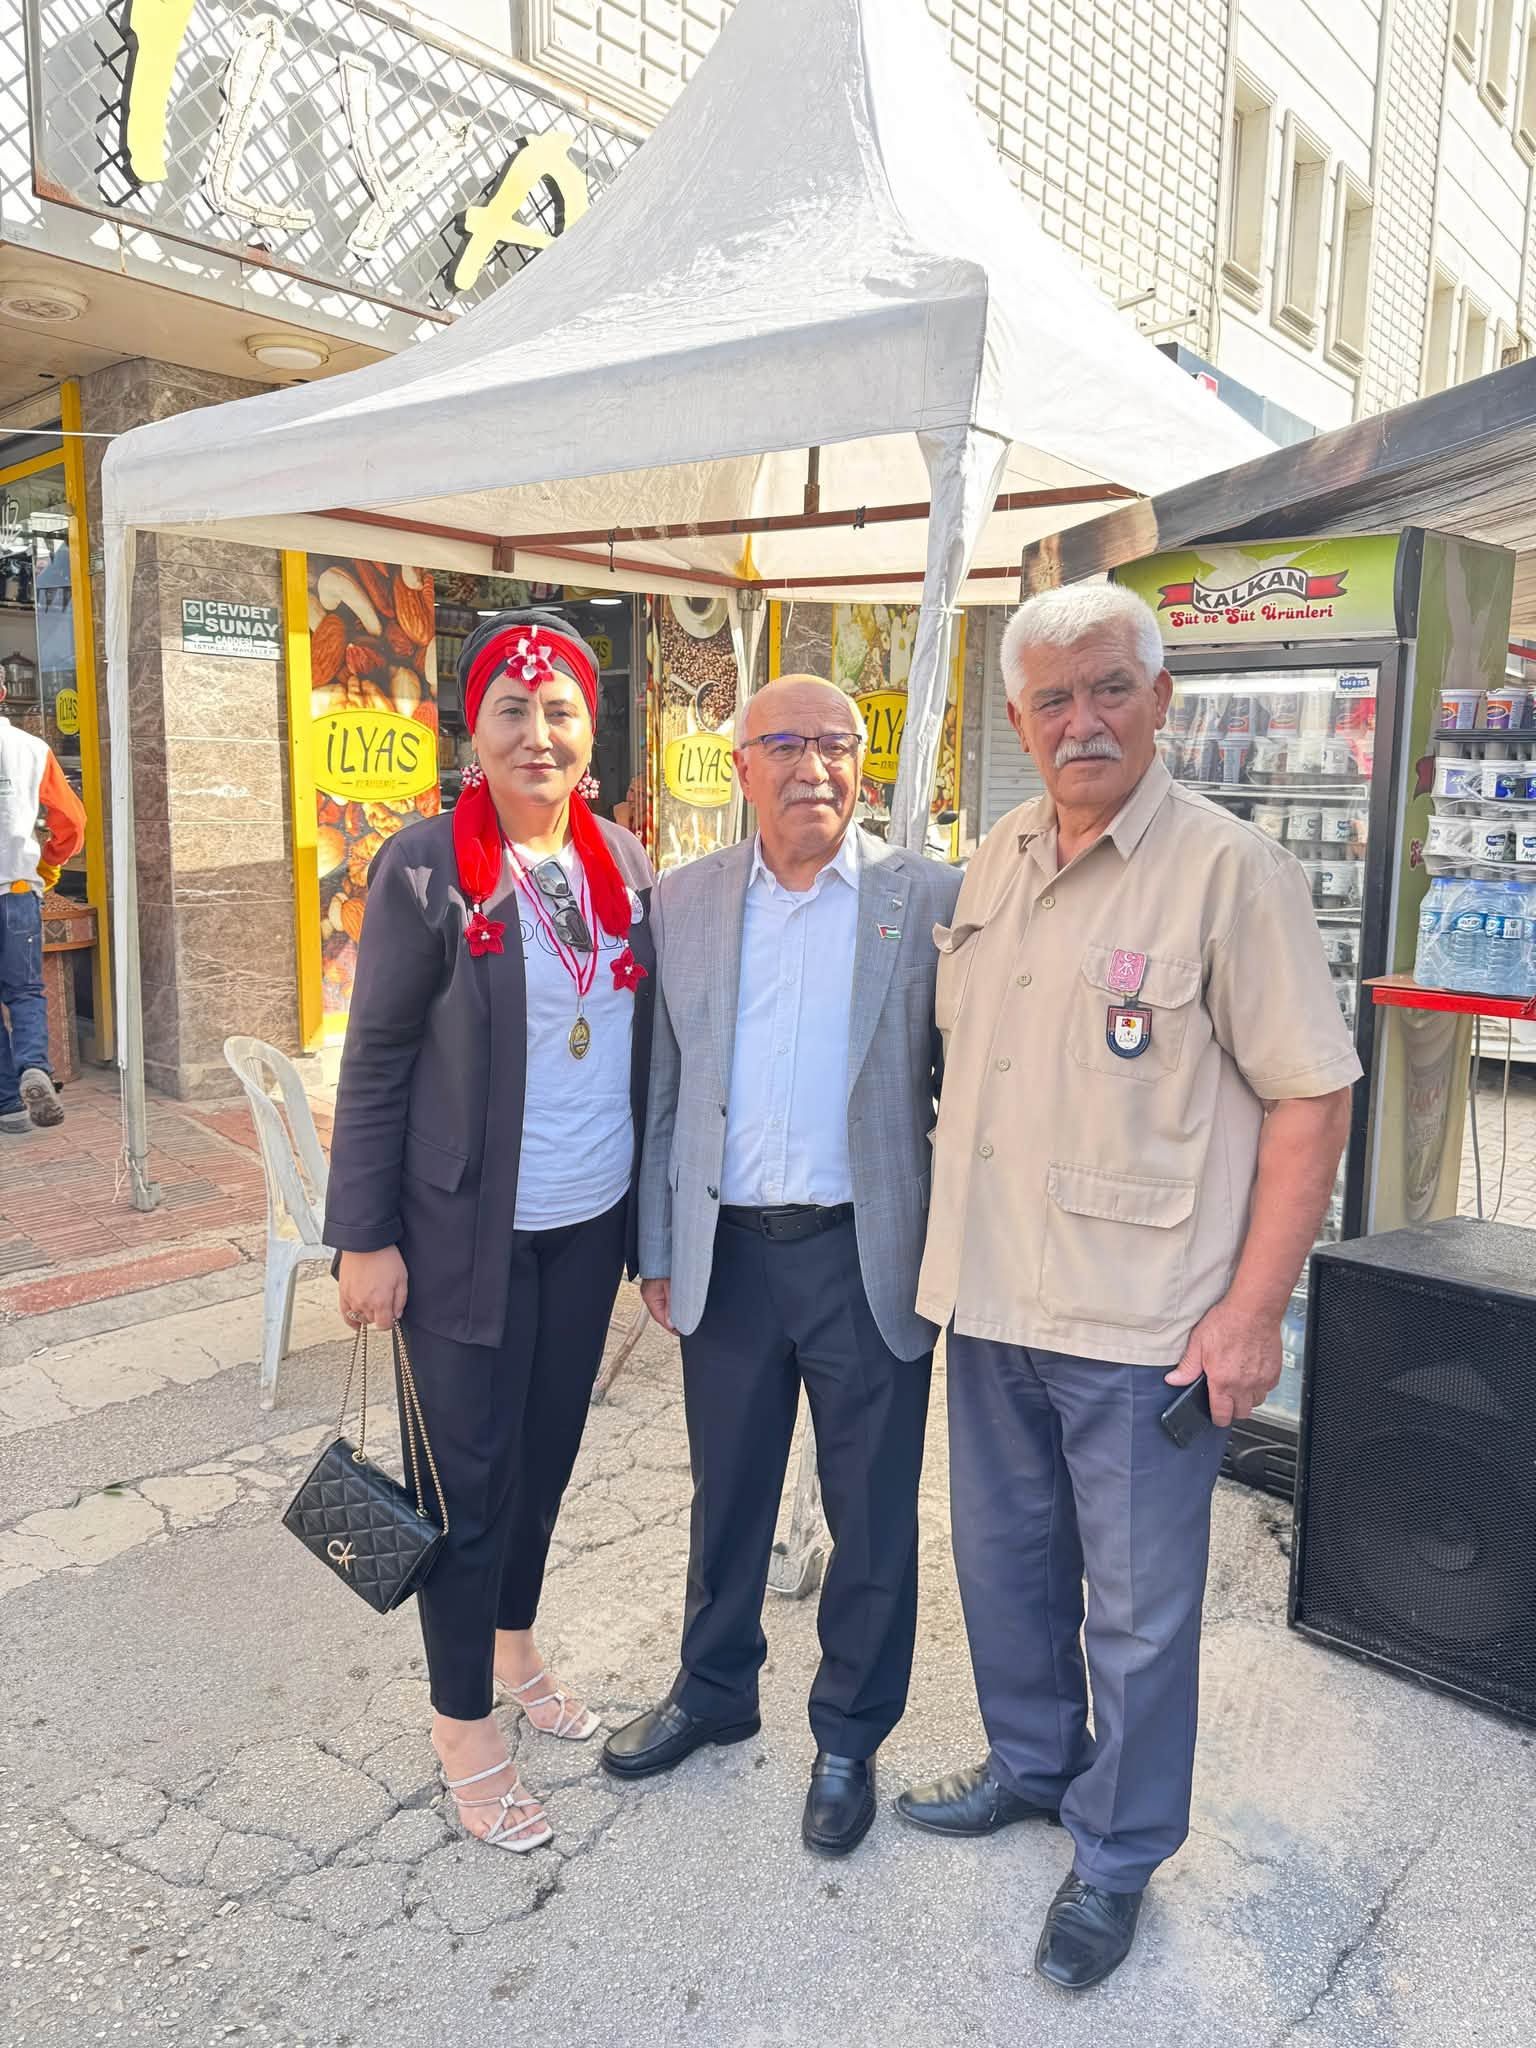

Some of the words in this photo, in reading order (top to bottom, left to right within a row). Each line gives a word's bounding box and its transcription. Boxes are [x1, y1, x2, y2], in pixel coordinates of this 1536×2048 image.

[1195, 571, 1305, 609] KALKAN
[204, 601, 271, 620] CEVDET
[1170, 611, 1200, 627] Süt
[1203, 613, 1219, 624] ve
[1225, 607, 1256, 624] Süt
[1261, 603, 1333, 622] Ürünleri
[204, 617, 279, 638] SUNAY
[327, 720, 420, 775] İLYAS
[678, 743, 732, 784] İLYAS
